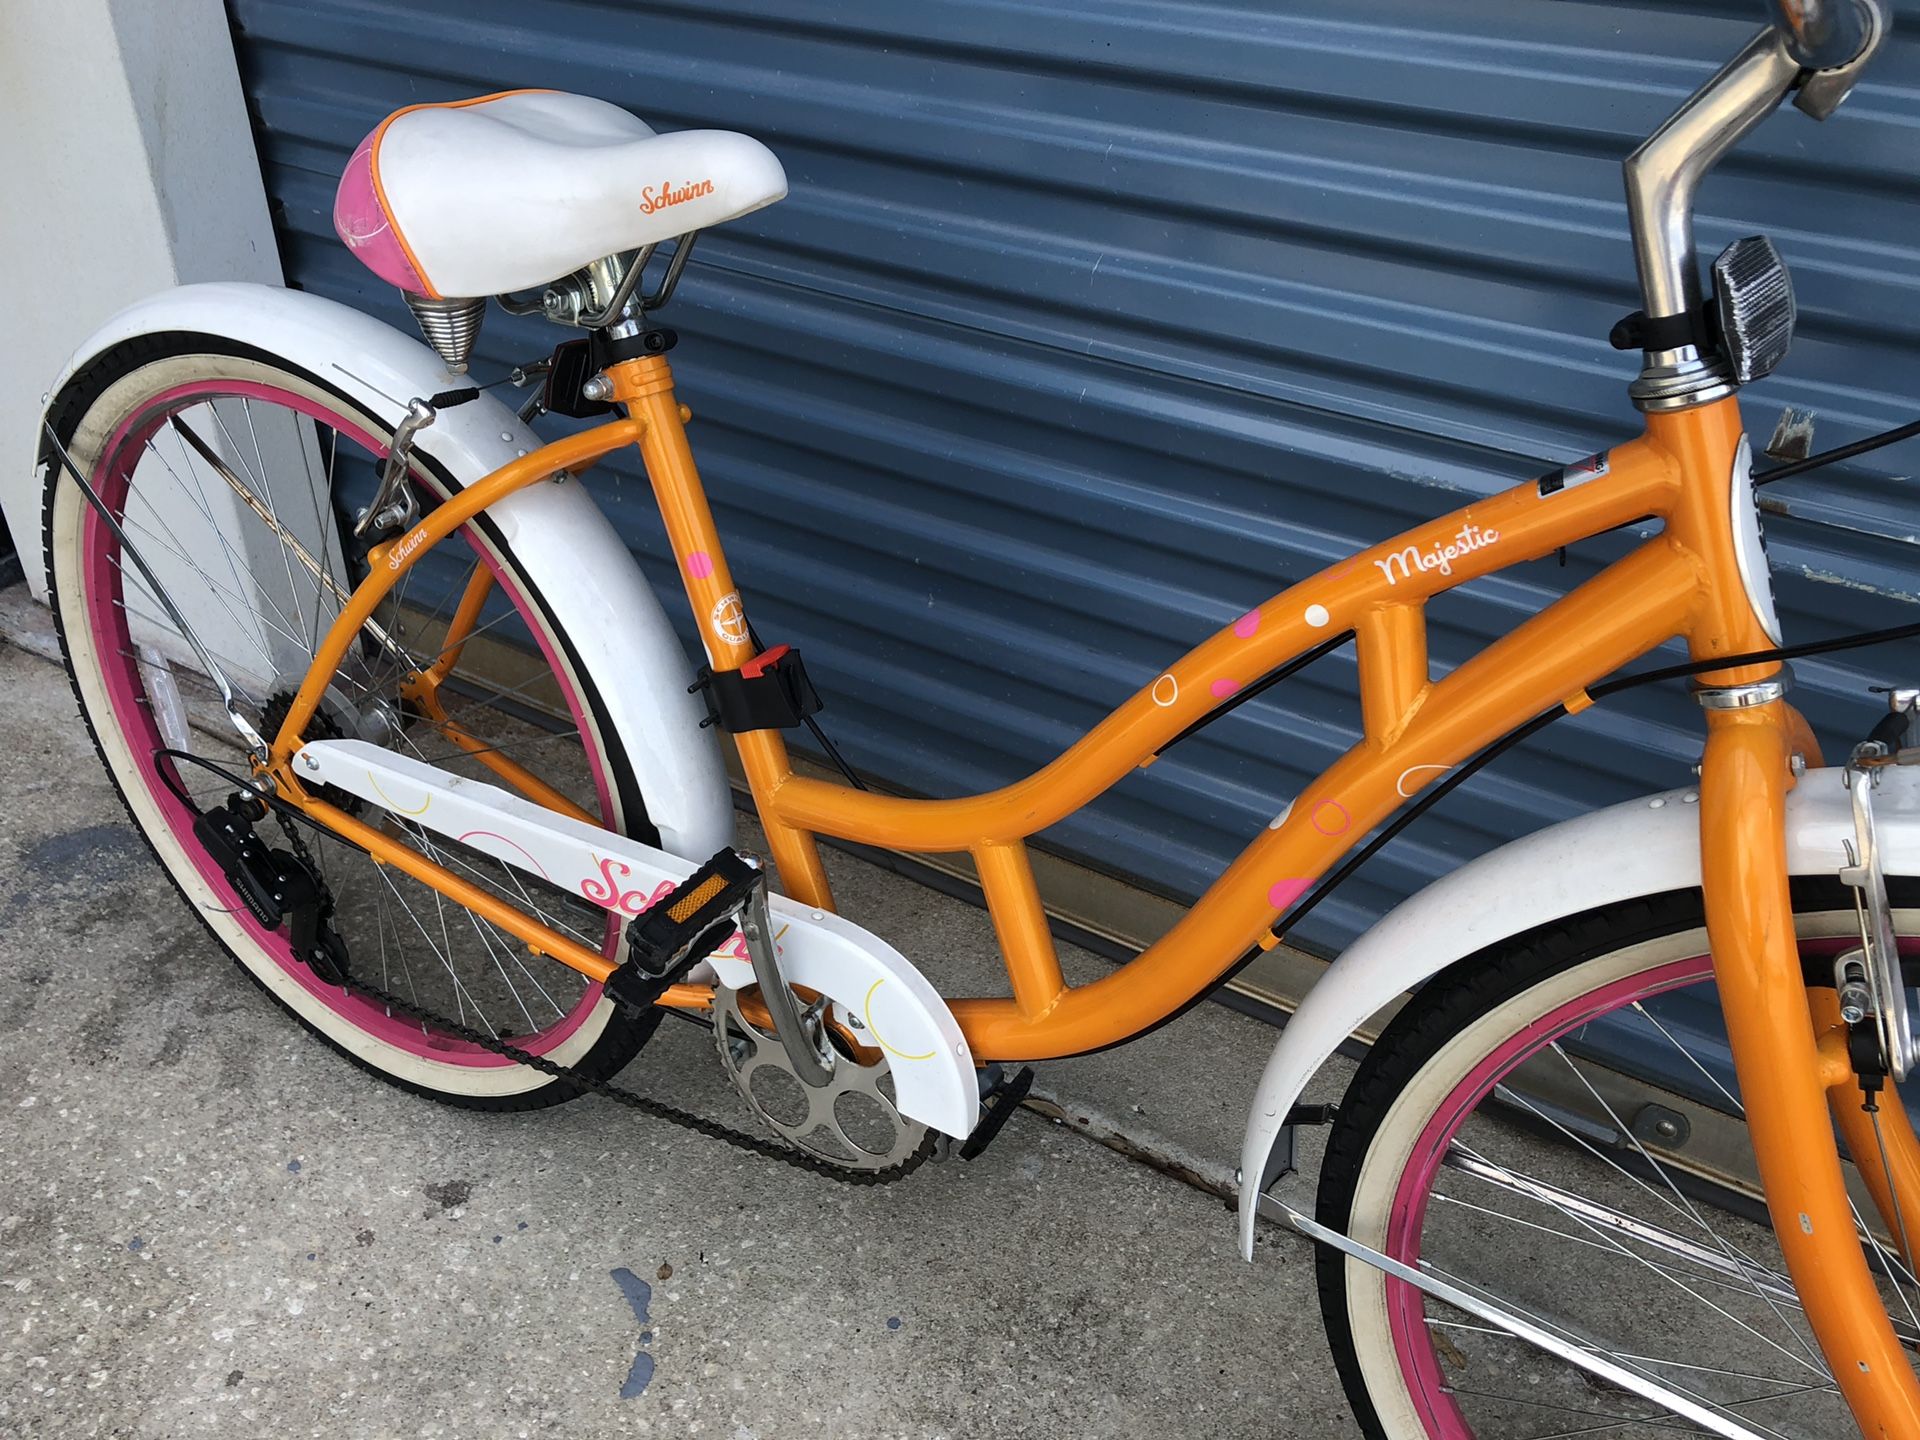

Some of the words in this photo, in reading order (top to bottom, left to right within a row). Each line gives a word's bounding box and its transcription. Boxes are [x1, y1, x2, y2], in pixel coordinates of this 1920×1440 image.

[640, 180, 714, 214] Schwinn
[389, 528, 428, 570] Schwinn
[1374, 524, 1499, 585] Majestic
[236, 877, 269, 922] SHIMANO
